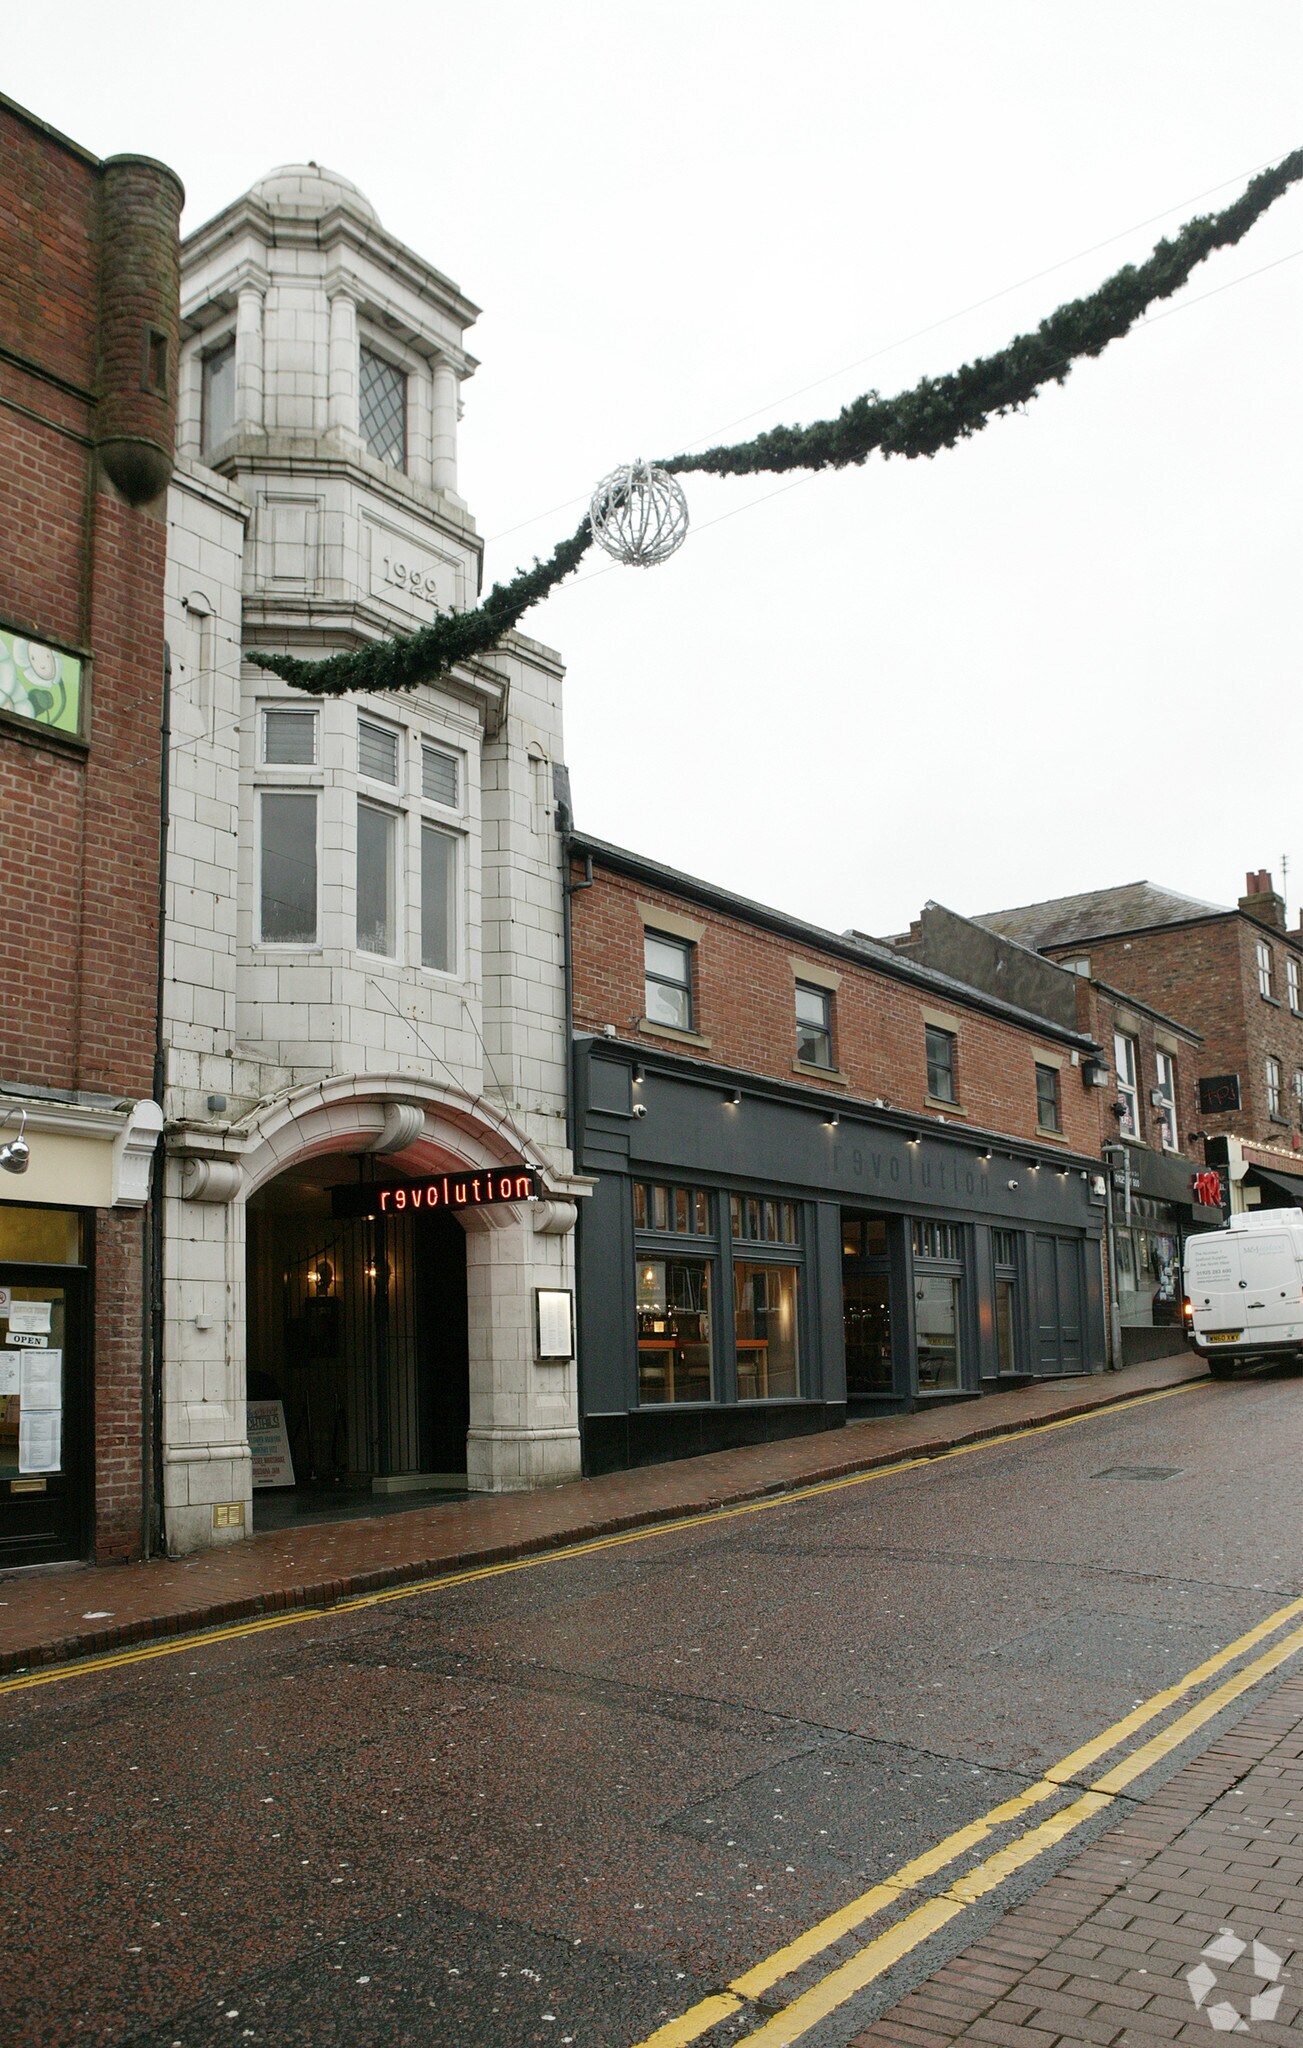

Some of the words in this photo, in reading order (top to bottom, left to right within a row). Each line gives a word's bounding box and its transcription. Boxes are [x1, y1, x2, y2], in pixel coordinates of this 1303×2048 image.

[383, 556, 440, 608] 1922
[380, 1172, 531, 1211] revolution
[833, 1145, 989, 1198] revolution
[13, 1335, 42, 1345] OPEN
